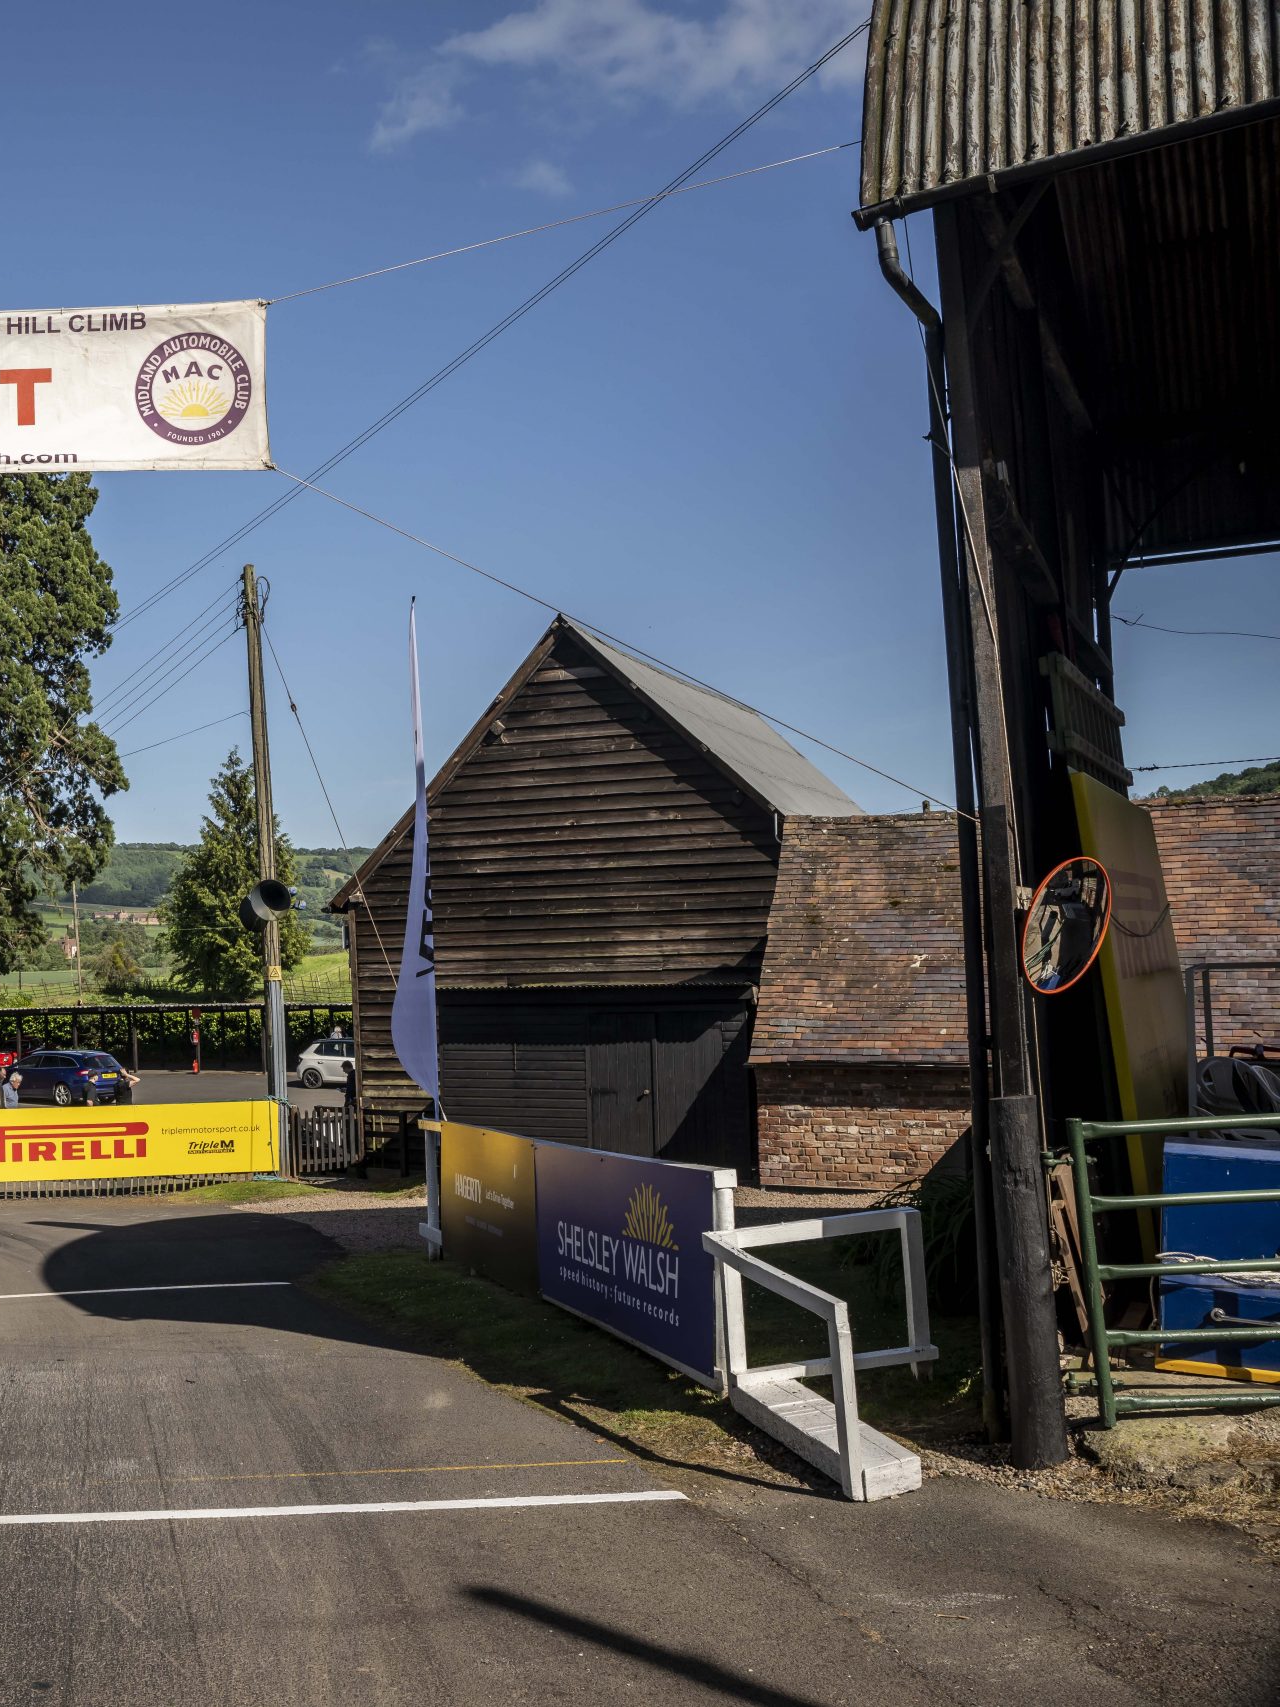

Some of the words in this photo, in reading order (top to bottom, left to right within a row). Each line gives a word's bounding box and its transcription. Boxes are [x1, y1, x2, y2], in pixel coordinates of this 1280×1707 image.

[6, 315, 61, 335] HILL
[68, 312, 147, 332] CLIMB
[138, 354, 162, 417] MIDLAND
[163, 335, 244, 371] AUTOMOBILE
[234, 374, 249, 410] CLUB
[162, 361, 223, 384] MAC
[167, 431, 204, 443] FOUNDED
[208, 428, 225, 440] 1901
[161, 1125, 260, 1135] triplemmotorsport.co.uk
[455, 1172, 482, 1204] HAGERTY
[557, 1220, 619, 1276] SHELSLEY
[622, 1240, 679, 1299] WALSH
[559, 1265, 580, 1283] speed
[643, 1300, 680, 1327] records
